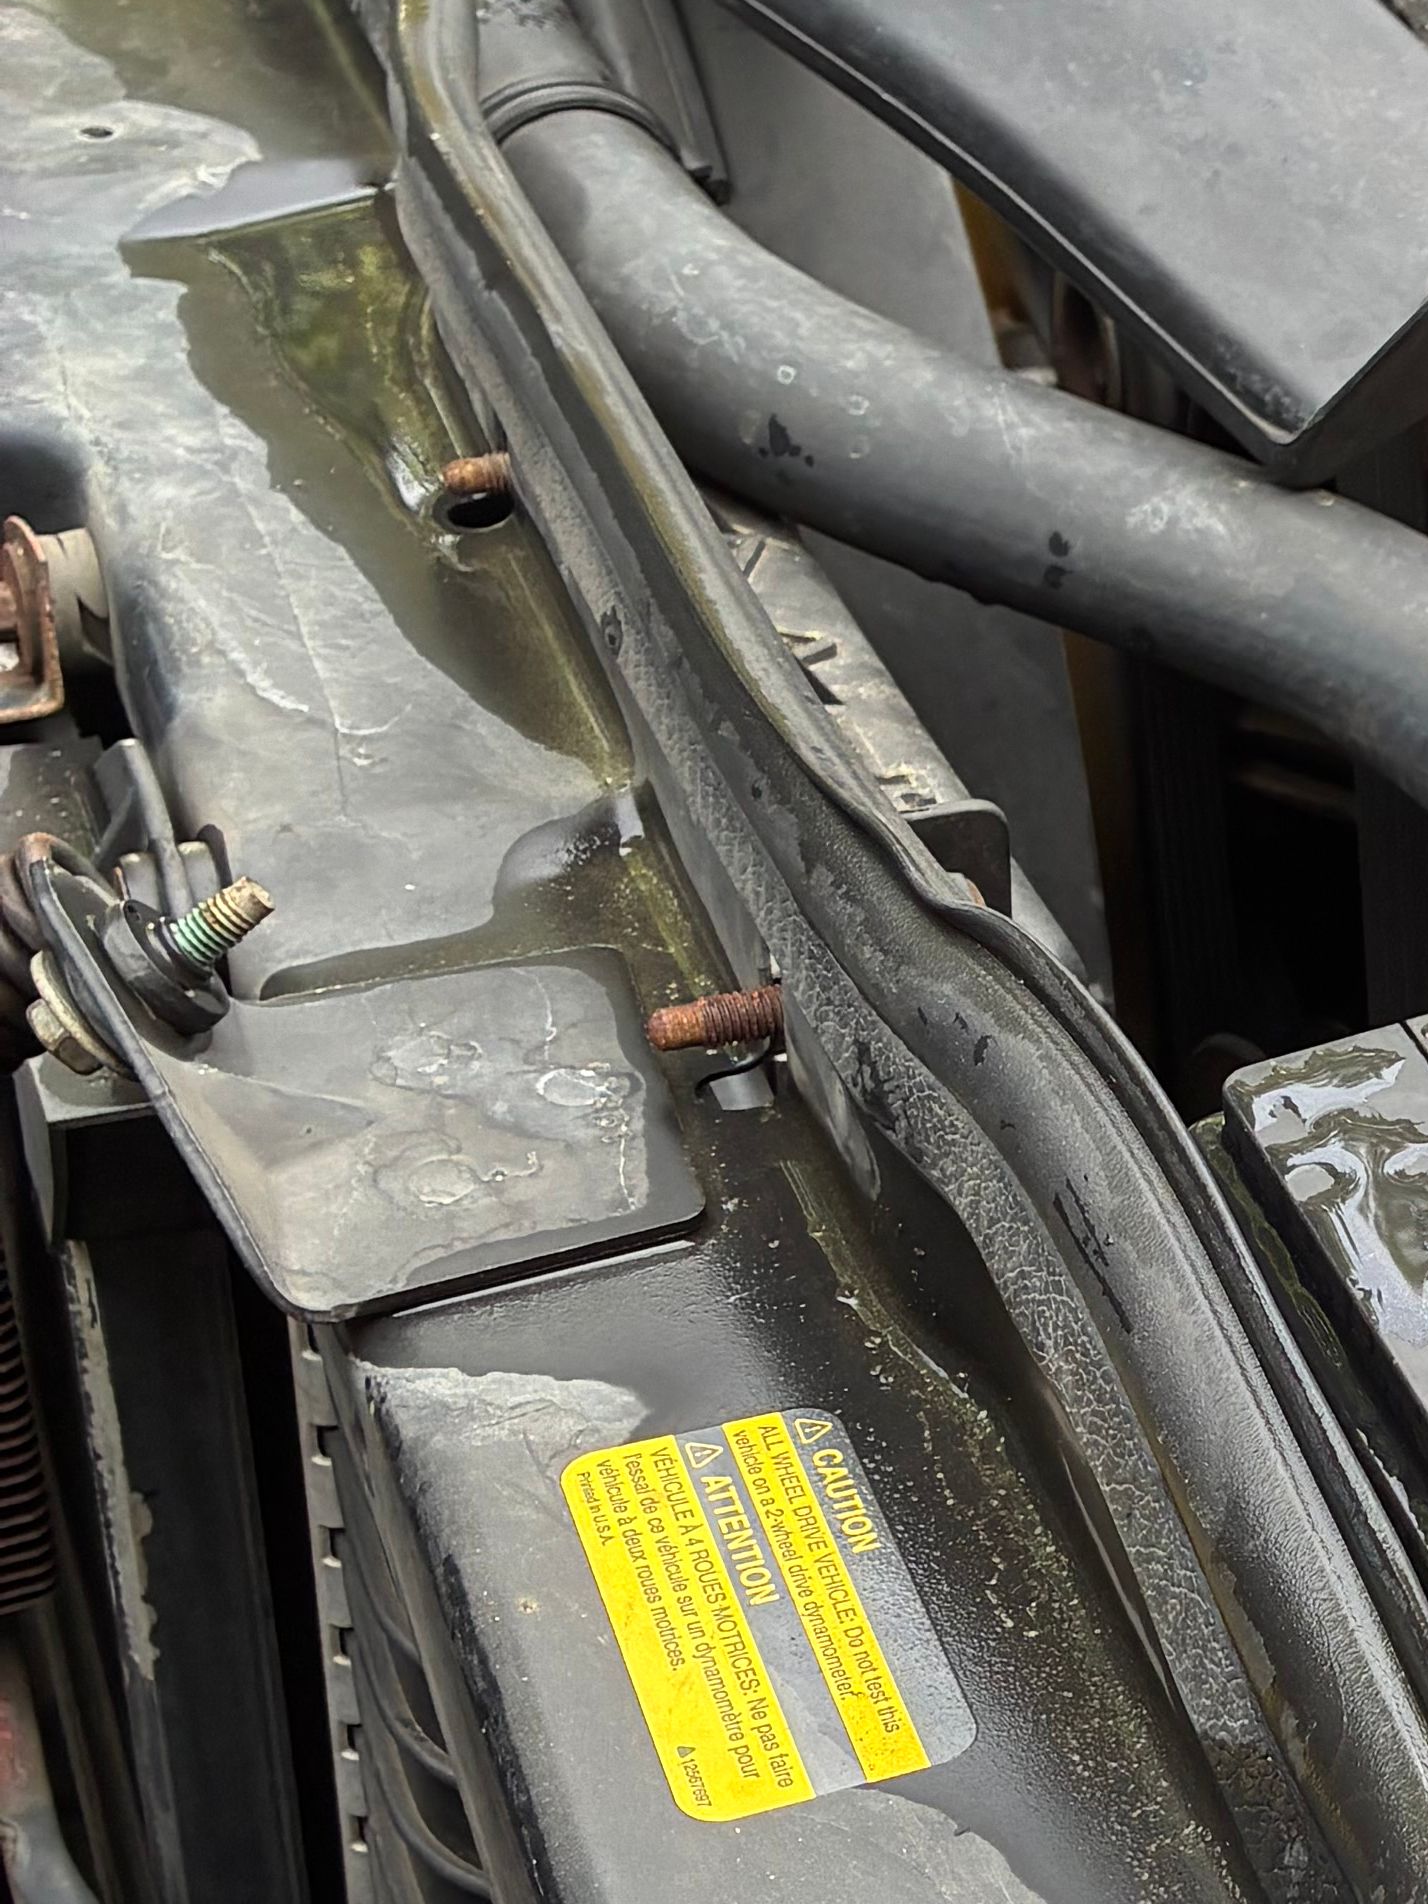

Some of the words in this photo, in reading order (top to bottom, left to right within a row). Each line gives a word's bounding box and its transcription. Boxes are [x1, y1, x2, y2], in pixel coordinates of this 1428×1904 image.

[731, 1429, 765, 1475] vehicle
[757, 1425, 784, 1451] ALL
[595, 1458, 631, 1513] véhicule
[621, 1452, 655, 1495] l'essai
[648, 1446, 695, 1522] VÉHICULE
[751, 1477, 771, 1495] on
[769, 1451, 807, 1504] WHEEL
[575, 1470, 600, 1504] Printed
[588, 1504, 601, 1514] in
[638, 1496, 661, 1514] de
[759, 1496, 775, 1507] a
[812, 1449, 875, 1553] CAUTION
[616, 1515, 638, 1526] à
[646, 1516, 665, 1534] ce
[677, 1522, 704, 1536] À
[764, 1507, 804, 1562] 2-wheel
[791, 1504, 829, 1552] DRIVE
[621, 1527, 648, 1562] deux
[684, 1537, 704, 1547] 4
[702, 1476, 774, 1605] ATTENTION
[654, 1534, 690, 1593] véhicule
[688, 1548, 727, 1604] ROUES
[787, 1563, 814, 1598] drive
[634, 1563, 662, 1604] roues
[812, 1552, 858, 1624] VEHICLE:
[675, 1594, 698, 1617] sur
[649, 1605, 686, 1671] motrices.
[685, 1620, 706, 1640] un
[710, 1605, 761, 1691] MOTRICES:
[842, 1625, 865, 1648] Do
[800, 1600, 860, 1703] dynamometer.
[852, 1649, 879, 1674] not
[691, 1641, 745, 1742] dynamomètre
[863, 1675, 892, 1704] test
[746, 1696, 769, 1720] Ne
[876, 1705, 902, 1733] this
[749, 1723, 780, 1751] pas
[727, 1744, 761, 1778] pour
[767, 1752, 794, 1788] faire
[679, 1757, 712, 1807] 12567697
